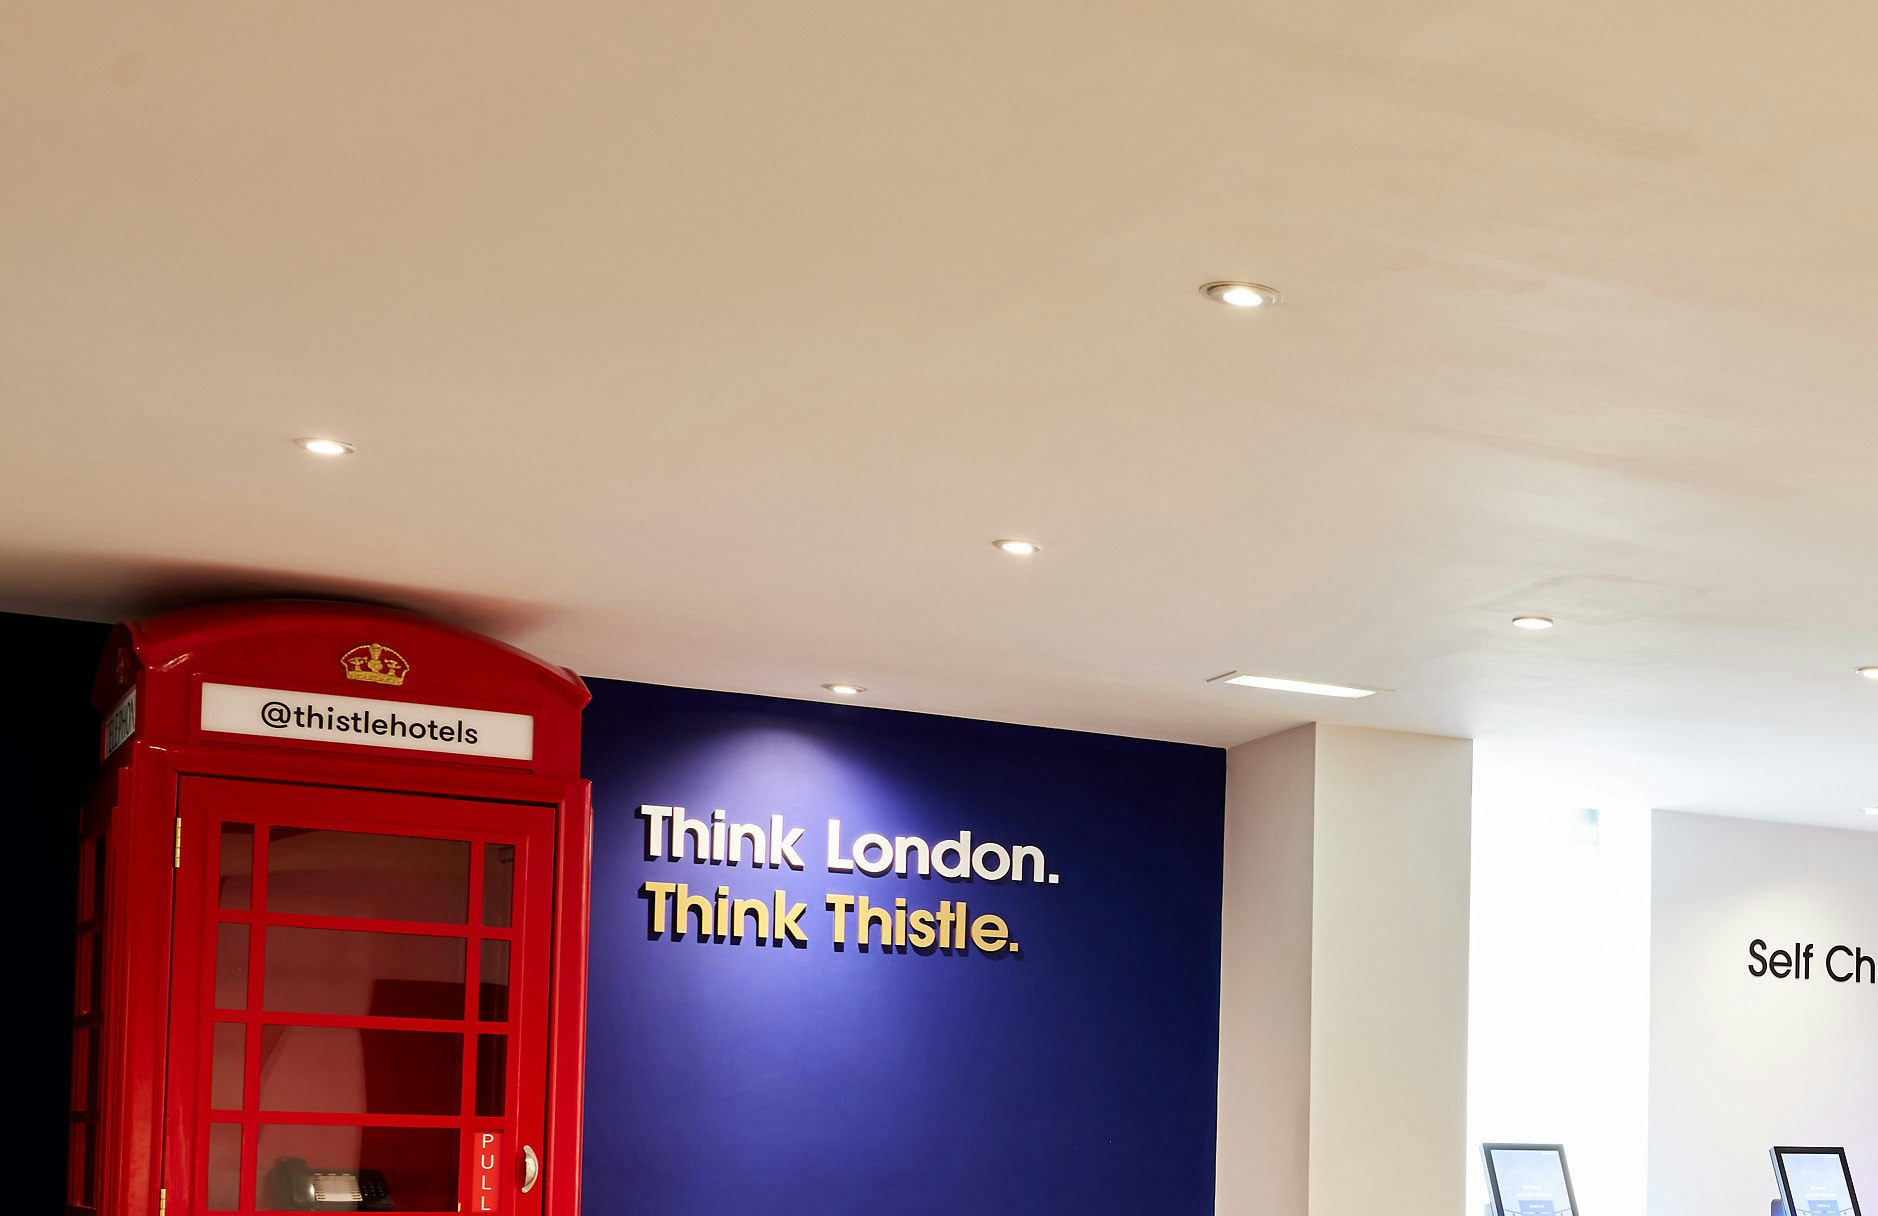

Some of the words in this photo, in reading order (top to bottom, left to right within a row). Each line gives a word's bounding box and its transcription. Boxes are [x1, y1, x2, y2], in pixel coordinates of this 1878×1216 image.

[260, 701, 479, 744] @thistlehotels
[639, 804, 805, 871] Think
[827, 818, 1060, 884] London.
[644, 881, 808, 943] Think
[825, 893, 1020, 953] Thistle.
[1748, 938, 1813, 980] Self
[481, 1133, 495, 1211] PULL
